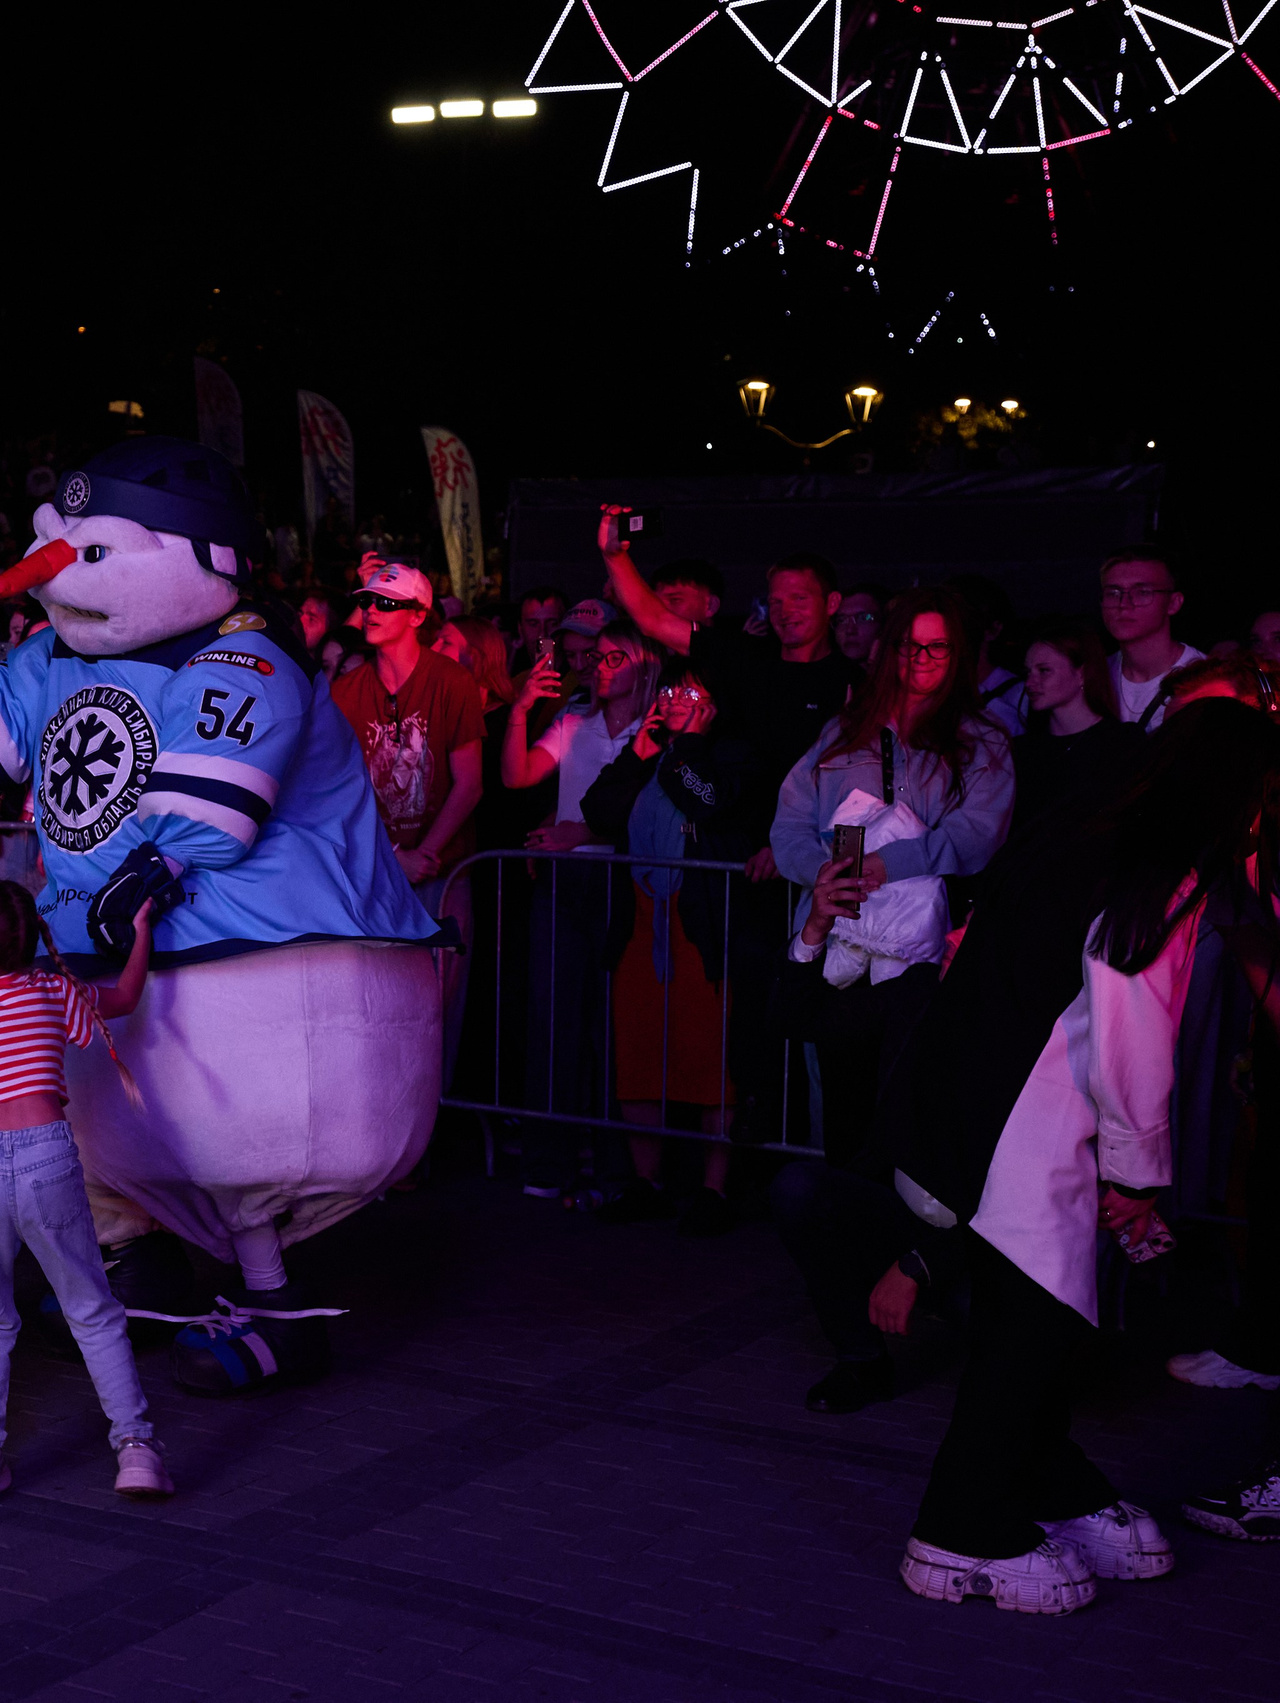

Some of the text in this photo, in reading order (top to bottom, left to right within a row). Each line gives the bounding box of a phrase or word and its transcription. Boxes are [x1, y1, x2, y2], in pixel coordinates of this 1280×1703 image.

[194, 652, 256, 667] WINLINE
[98, 689, 131, 713] КЛУБ
[125, 709, 153, 769] СИБИРЬ
[195, 688, 257, 746] 54
[93, 786, 143, 840] ОБЛАСТЬ
